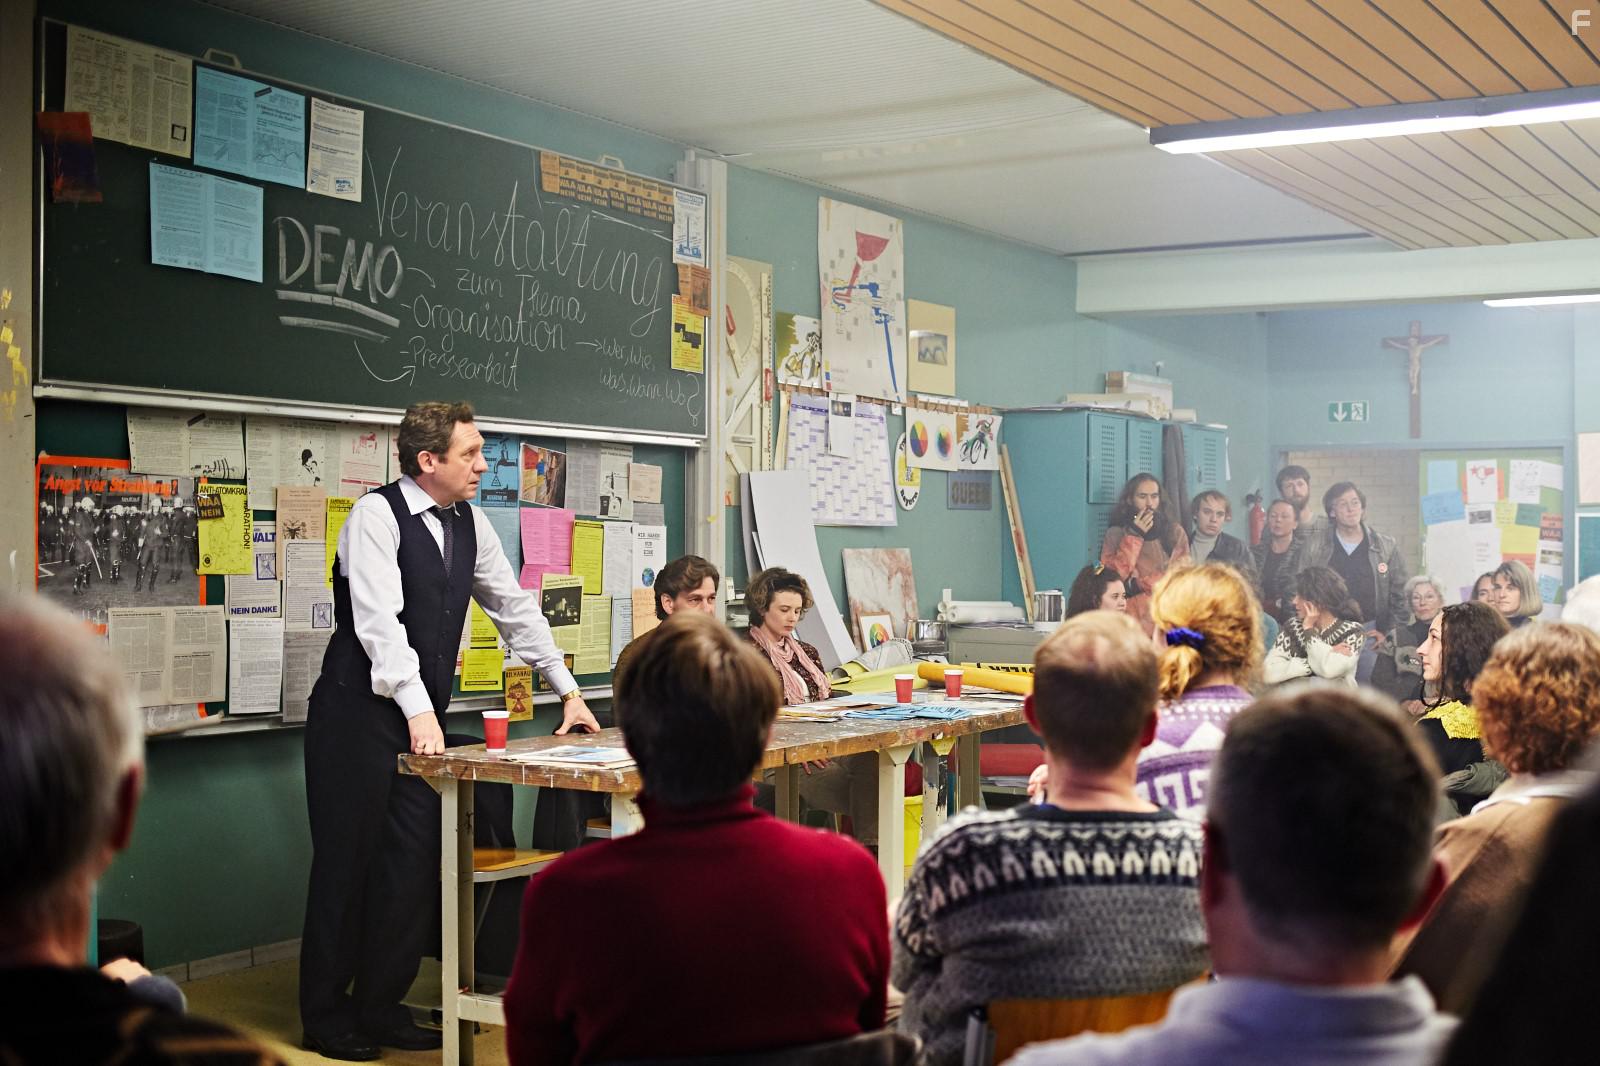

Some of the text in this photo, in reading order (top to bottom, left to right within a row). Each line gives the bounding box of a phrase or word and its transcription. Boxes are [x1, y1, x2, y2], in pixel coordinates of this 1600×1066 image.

[366, 145, 664, 337] Veranstaltung
[273, 216, 402, 301] DEMO
[515, 274, 586, 324] Thema
[45, 475, 179, 497] Angst vor Strahlung?
[198, 497, 221, 507] WAA
[201, 507, 222, 518] NEIN
[231, 605, 278, 615] NEIN DANKE
